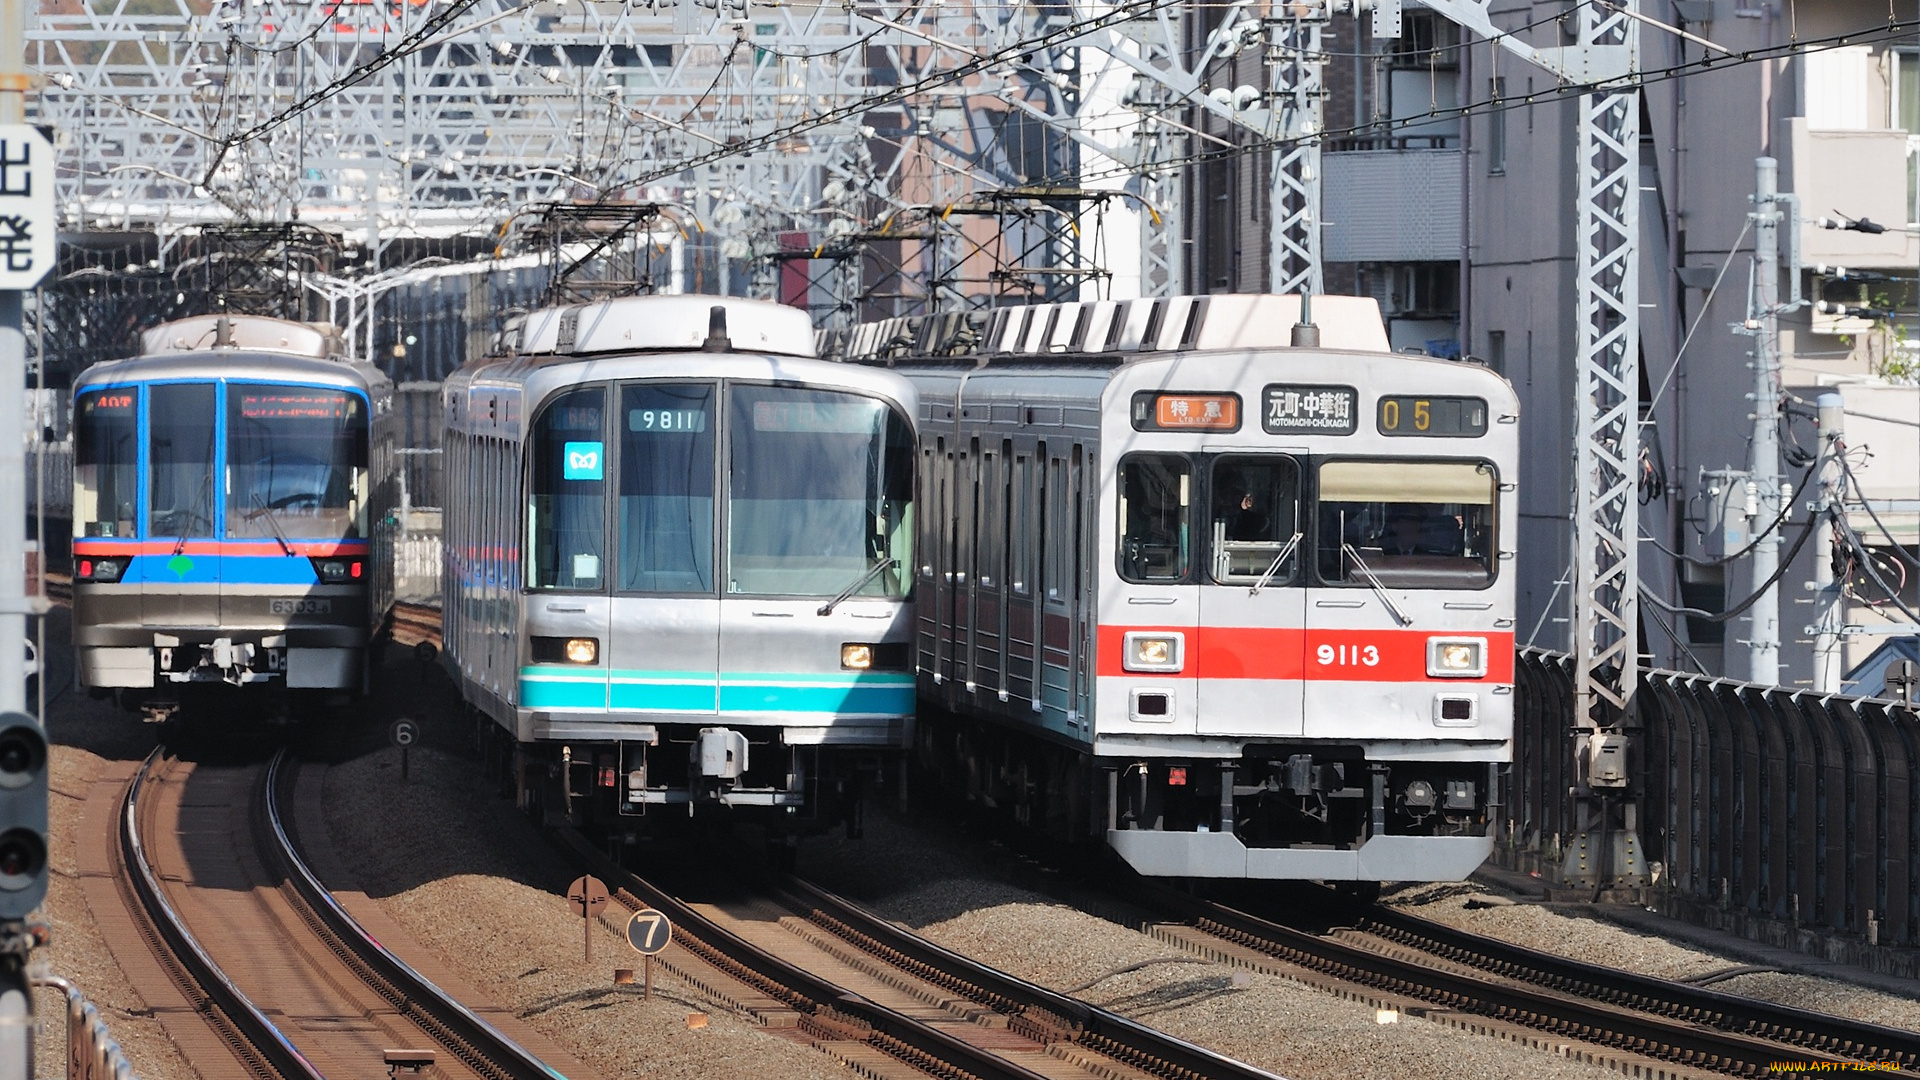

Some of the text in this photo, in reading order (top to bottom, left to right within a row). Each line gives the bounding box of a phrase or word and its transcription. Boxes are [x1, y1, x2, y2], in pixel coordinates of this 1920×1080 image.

[1170, 400, 1222, 417] 特急
[643, 411, 691, 429] 9811
[1317, 644, 1380, 667] 9113
[396, 723, 412, 745] 6
[637, 915, 661, 948] 7
